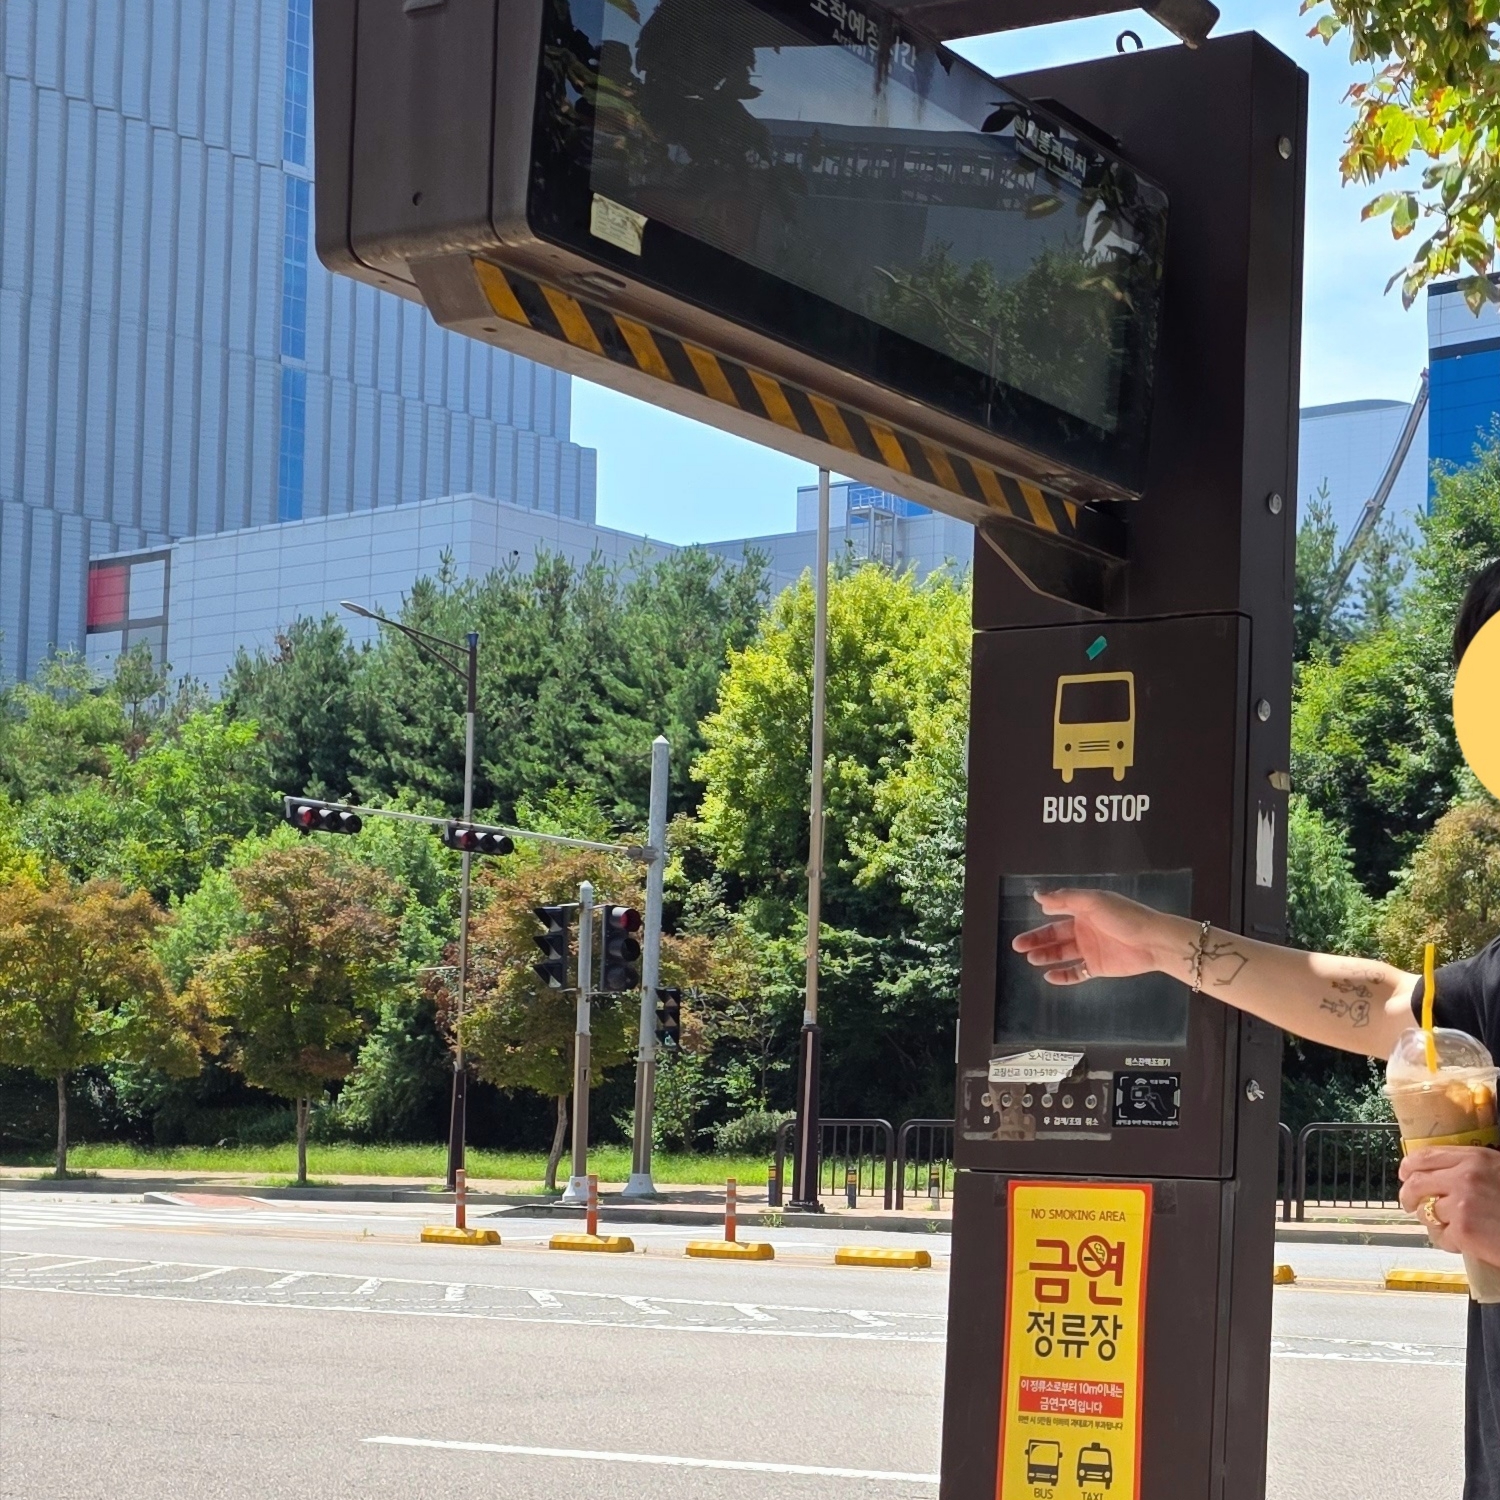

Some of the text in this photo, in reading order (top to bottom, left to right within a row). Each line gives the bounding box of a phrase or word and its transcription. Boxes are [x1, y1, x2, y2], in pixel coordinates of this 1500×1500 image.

[1043, 795, 1150, 823] BUS STOP
[1031, 1208, 1126, 1222] NO SMOKING AREA
[1028, 1234, 1125, 1306] 금연
[1026, 1311, 1123, 1361] 정류장
[1020, 1379, 1123, 1398] 이 정류소로부터 10m이내는
[1040, 1396, 1103, 1414] 금연구역입니다
[1033, 1487, 1054, 1500] BUS
